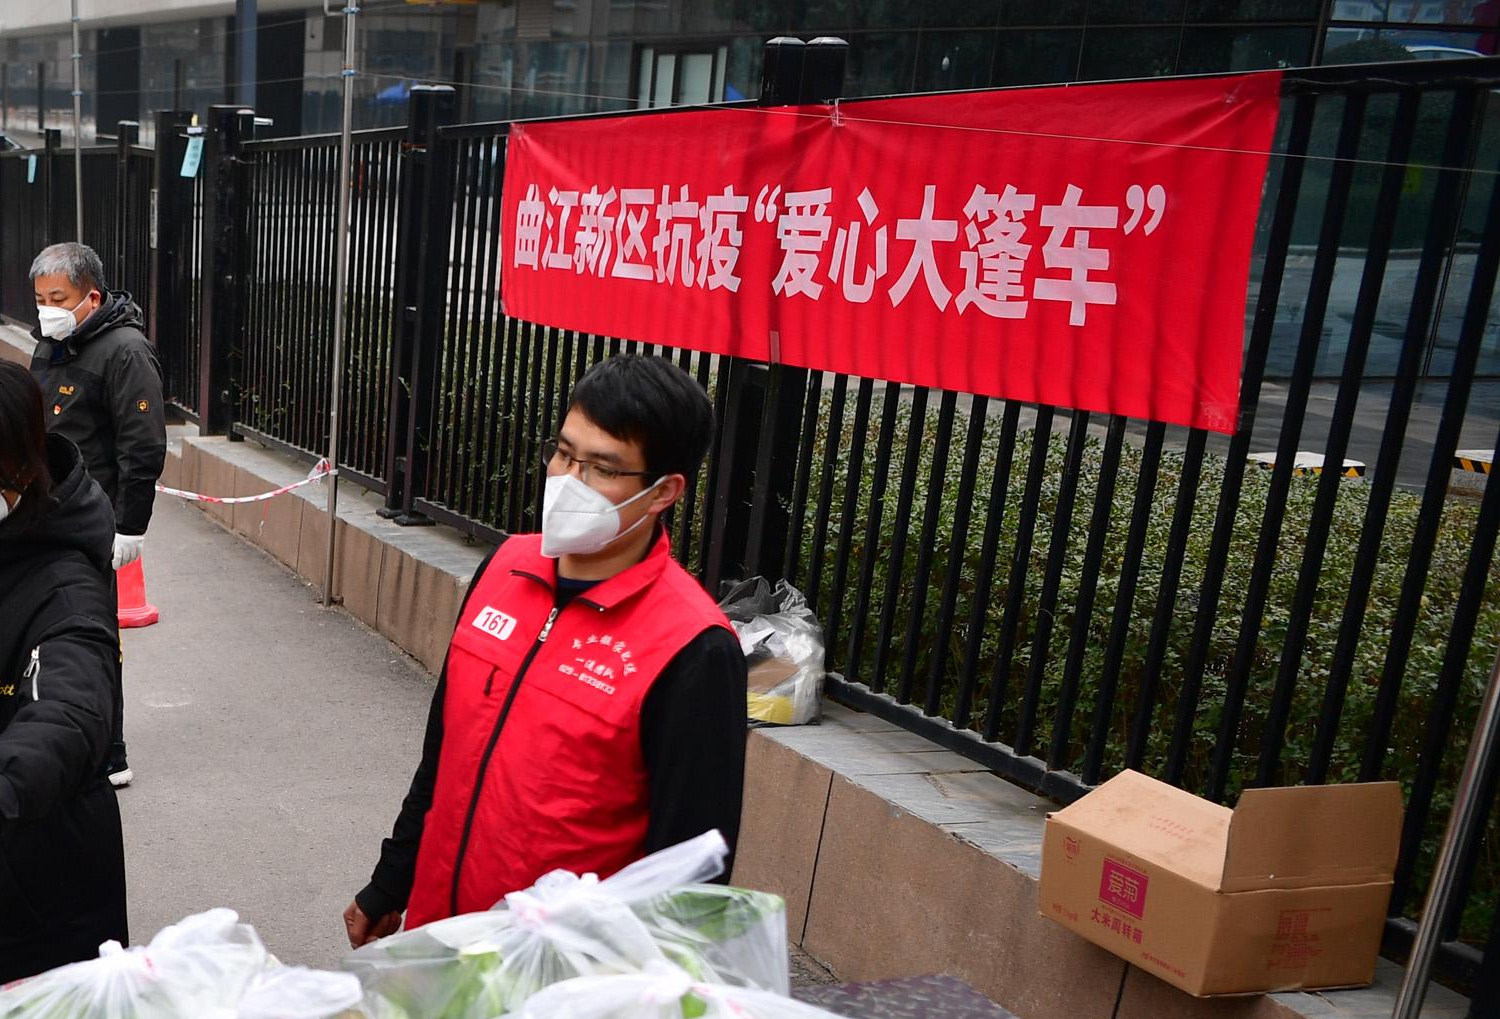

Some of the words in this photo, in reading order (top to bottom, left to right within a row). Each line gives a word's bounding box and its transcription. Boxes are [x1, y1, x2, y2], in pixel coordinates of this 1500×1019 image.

[513, 183, 1167, 327] 曲江新区抗疫“爱心大篷车”
[483, 611, 510, 635] 161
